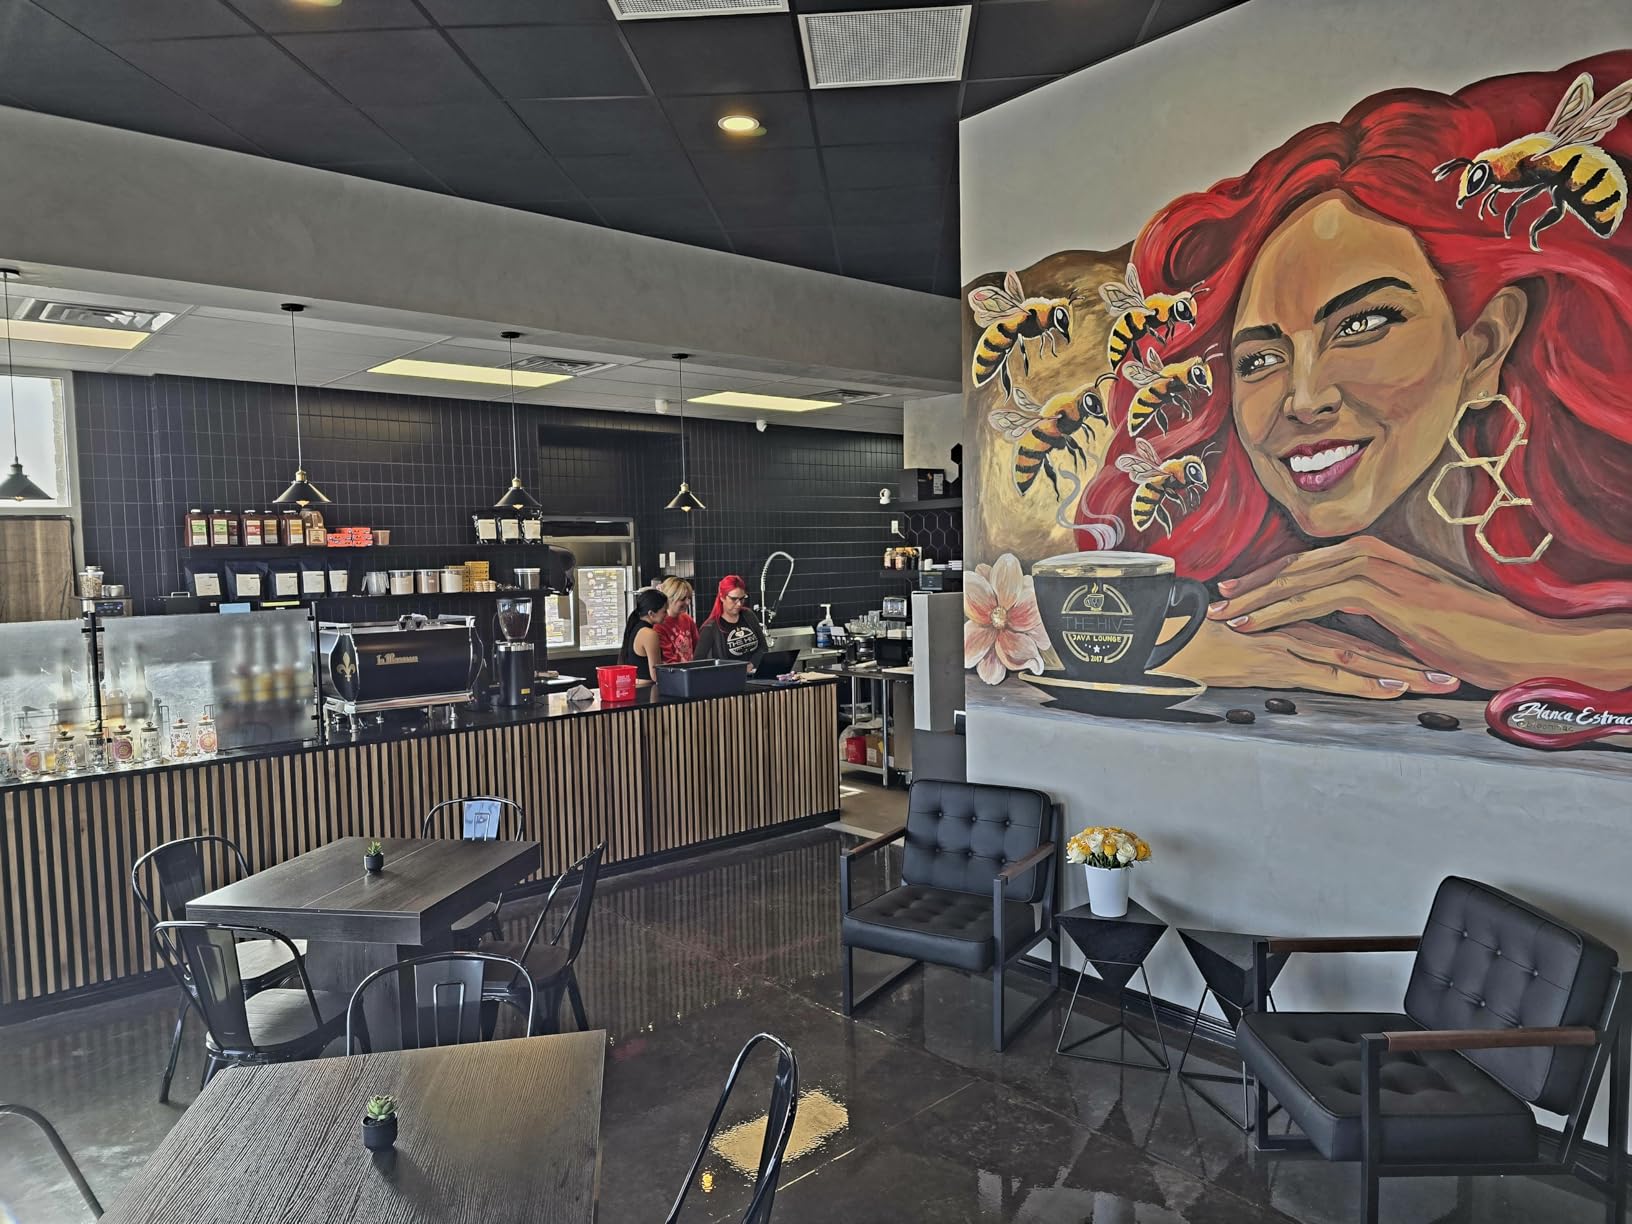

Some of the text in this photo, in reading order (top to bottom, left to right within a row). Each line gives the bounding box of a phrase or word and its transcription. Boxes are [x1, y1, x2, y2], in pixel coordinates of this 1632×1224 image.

[1062, 616, 1135, 632] THE HIVE
[1072, 634, 1122, 643] JAVA LOUNGE
[1511, 702, 1574, 722] Blanca
